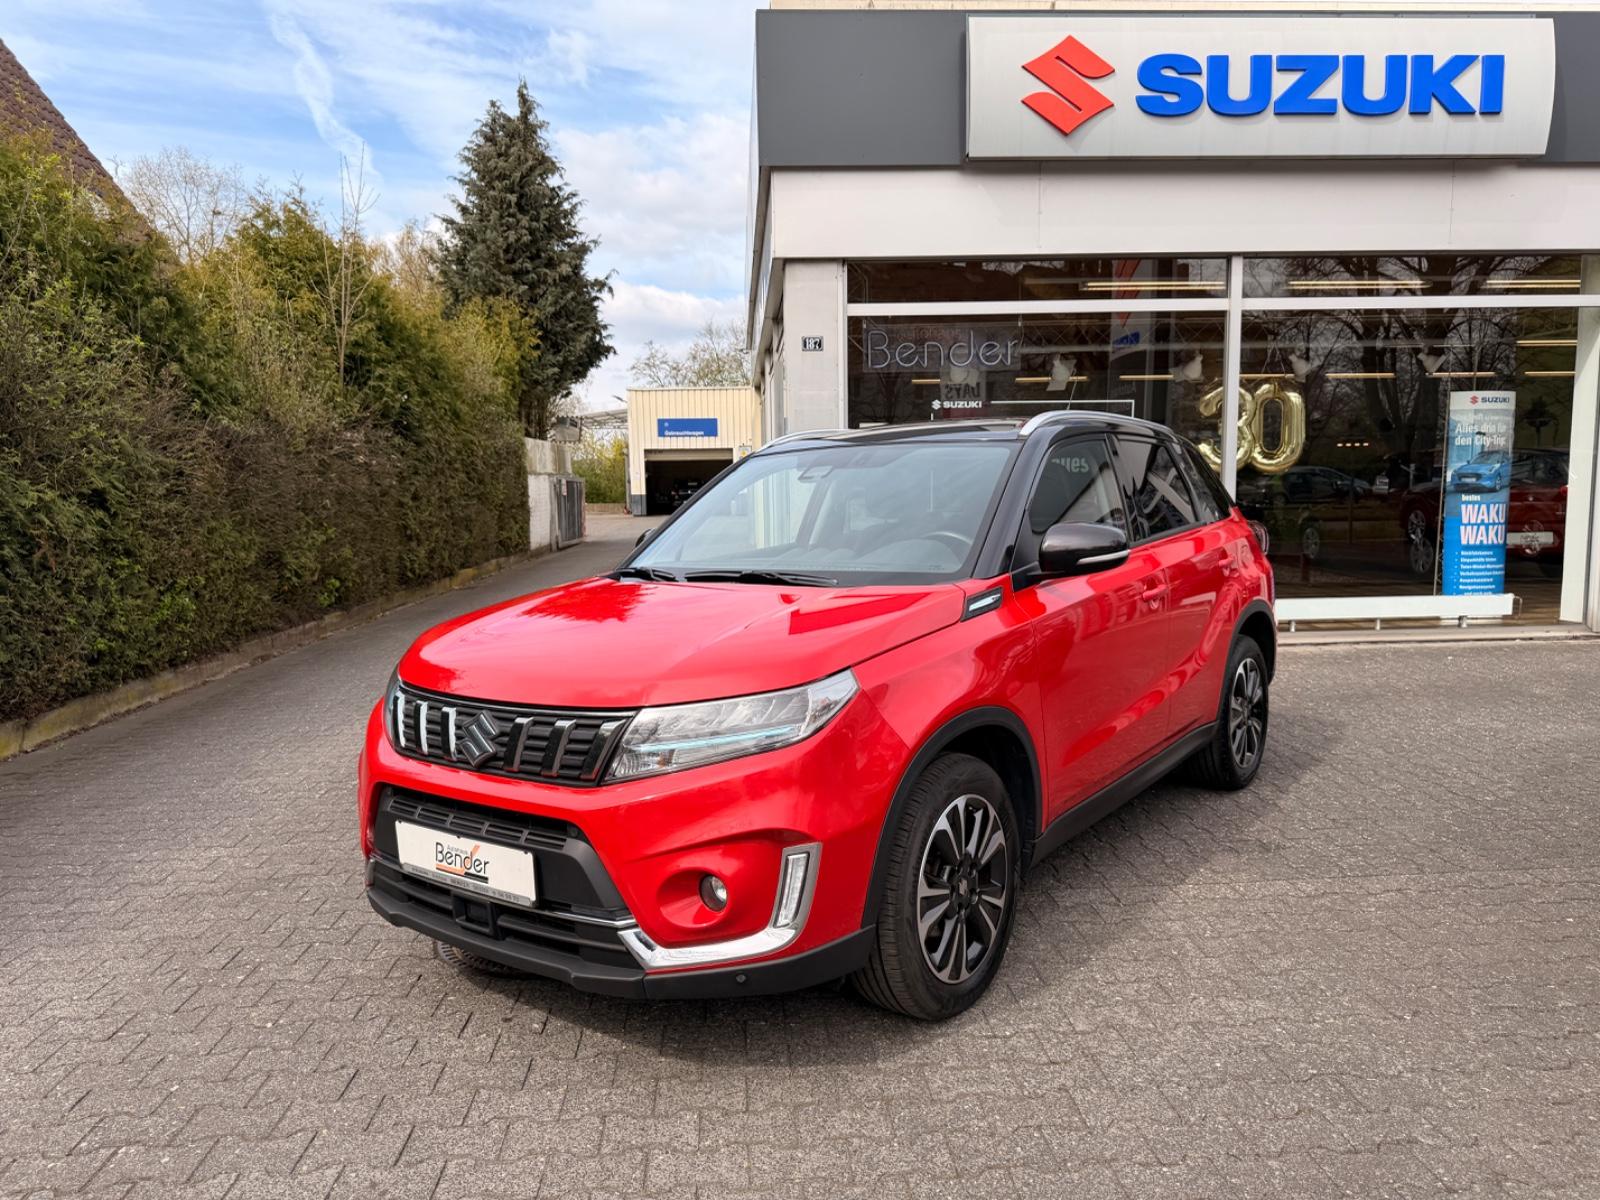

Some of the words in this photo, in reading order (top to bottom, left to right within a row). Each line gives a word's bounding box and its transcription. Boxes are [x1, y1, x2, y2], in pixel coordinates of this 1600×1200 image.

[1135, 53, 1506, 117] SUZUKI
[805, 338, 821, 350] 187
[868, 330, 1018, 369] Bender
[942, 400, 982, 409] SUZUKI
[1481, 396, 1510, 404] SUZUKI
[1455, 434, 1472, 446] den
[1461, 503, 1506, 524] WAKU
[1460, 524, 1505, 545] WAKU
[435, 842, 490, 874] Bender
